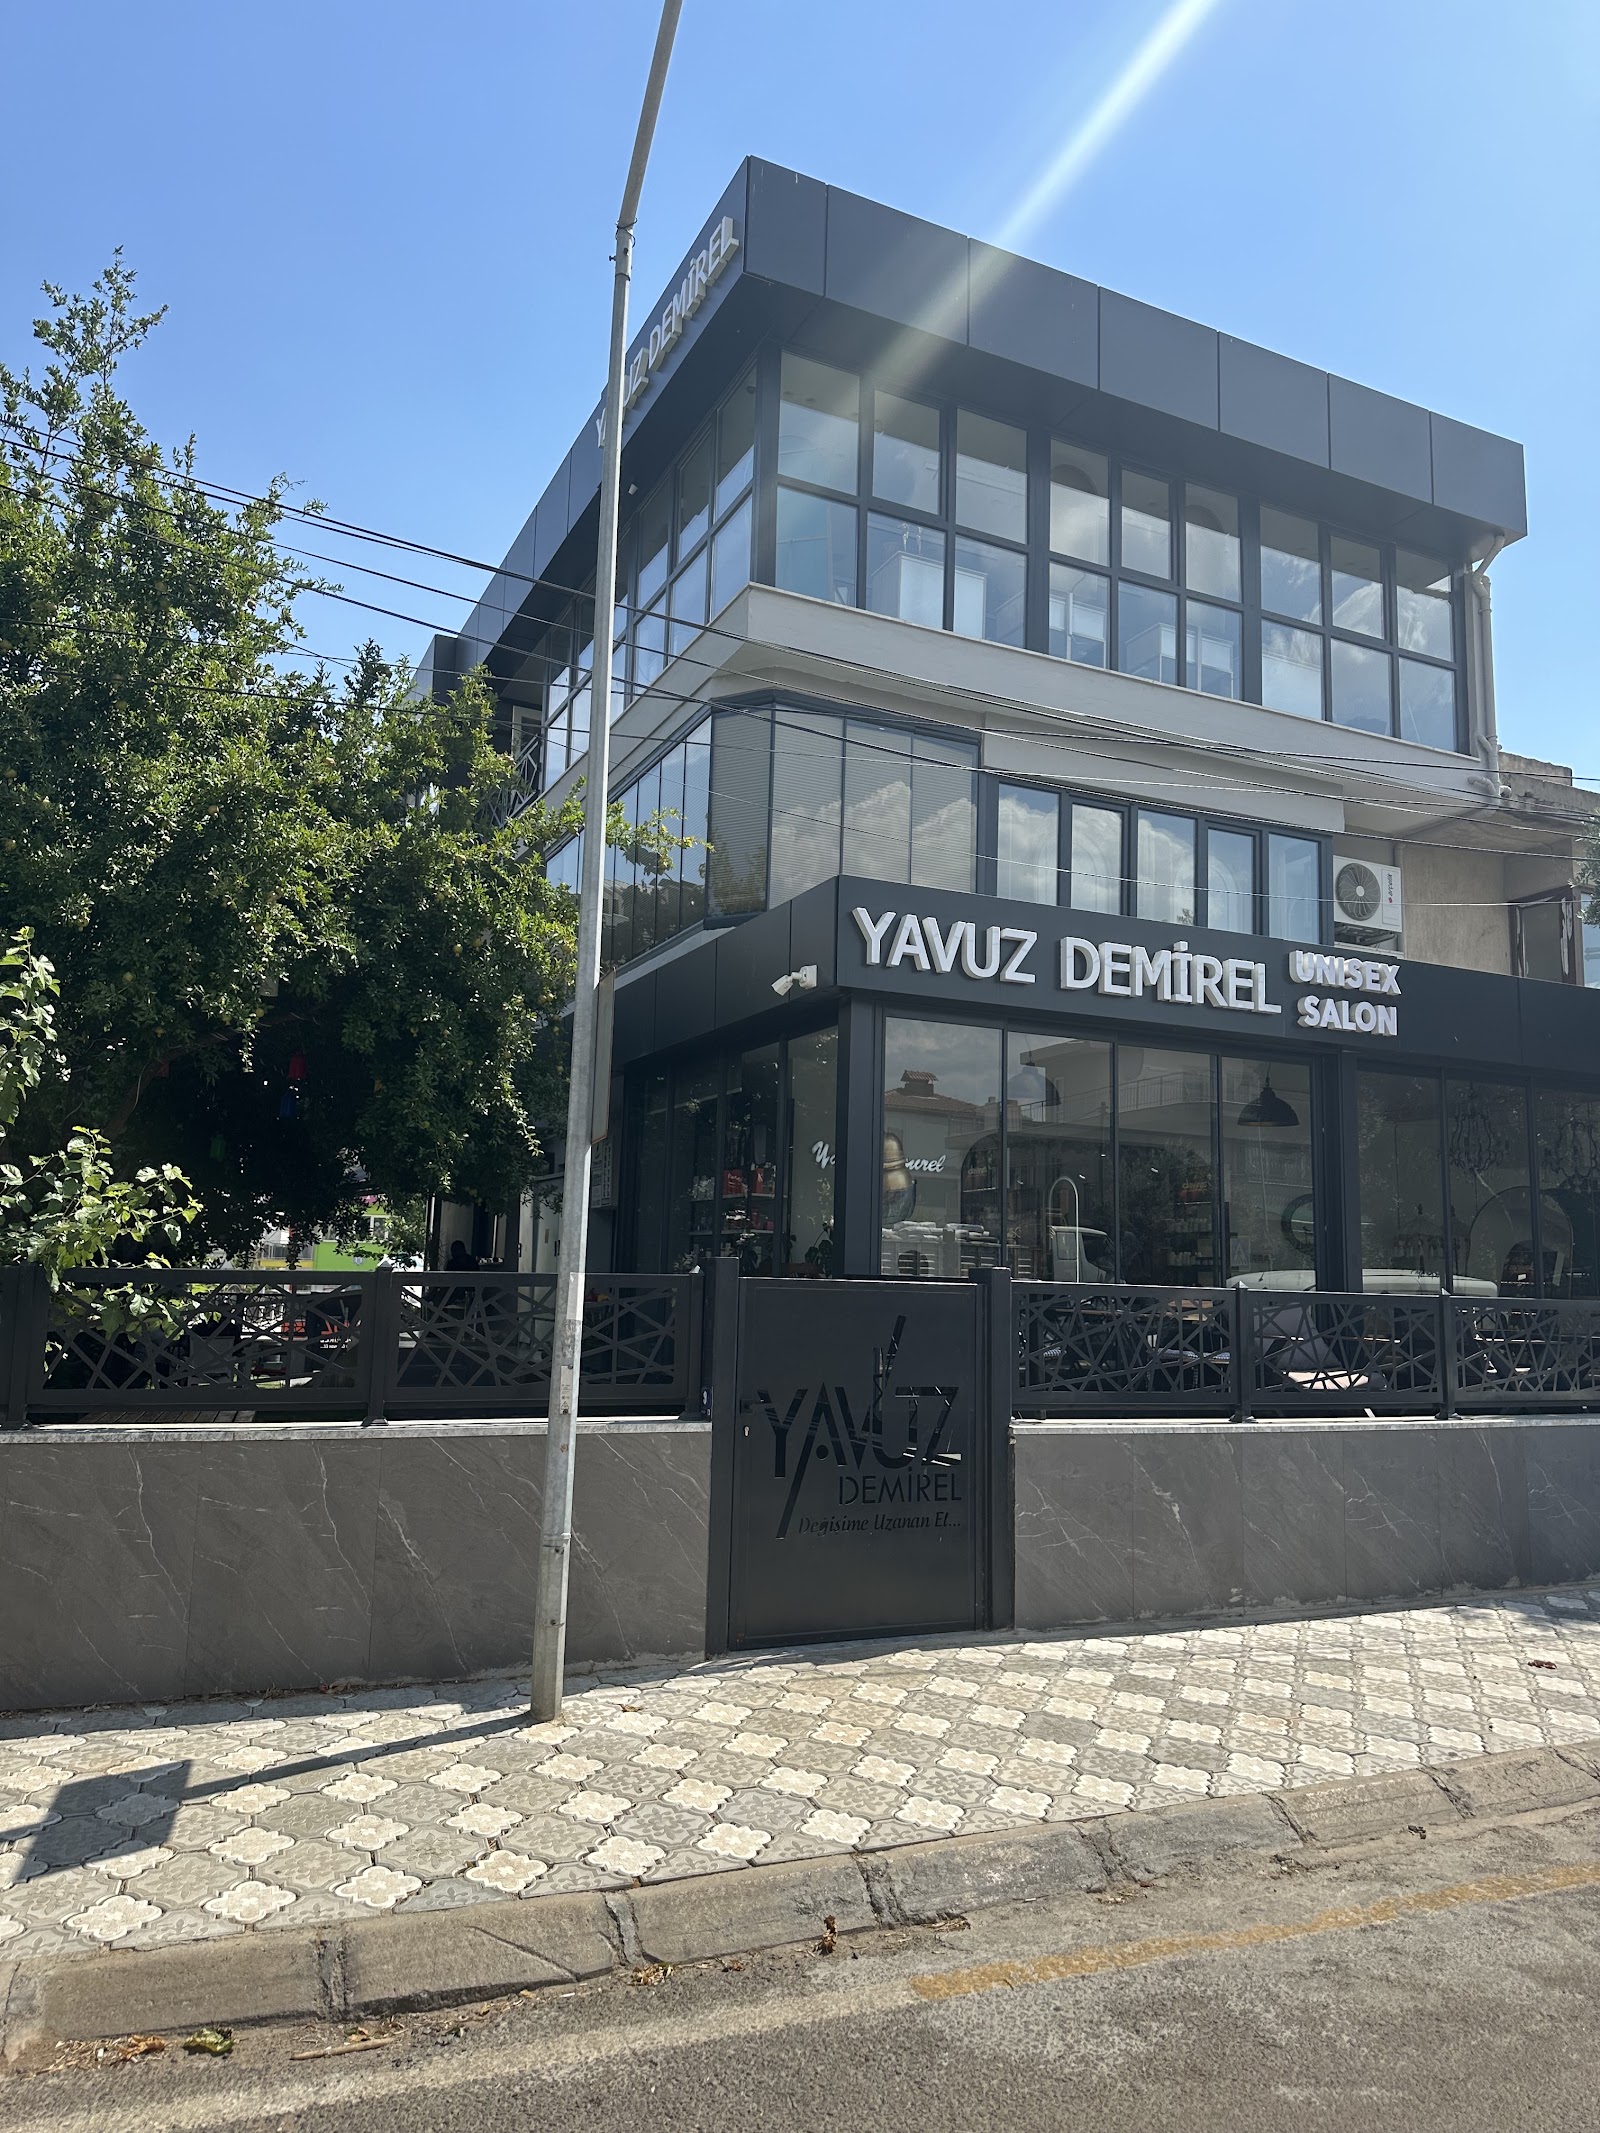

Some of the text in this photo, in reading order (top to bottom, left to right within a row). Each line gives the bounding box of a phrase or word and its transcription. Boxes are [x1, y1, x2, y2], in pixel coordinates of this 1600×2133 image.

[595, 215, 740, 448] YUZ DEMİREL
[851, 906, 1282, 1015] YAVUZ DEMİREL
[1288, 949, 1402, 996] UNISEX
[1297, 994, 1399, 1036] SALON
[838, 1467, 962, 1506] DEMİREL
[874, 1513, 930, 1532] Uzanan
